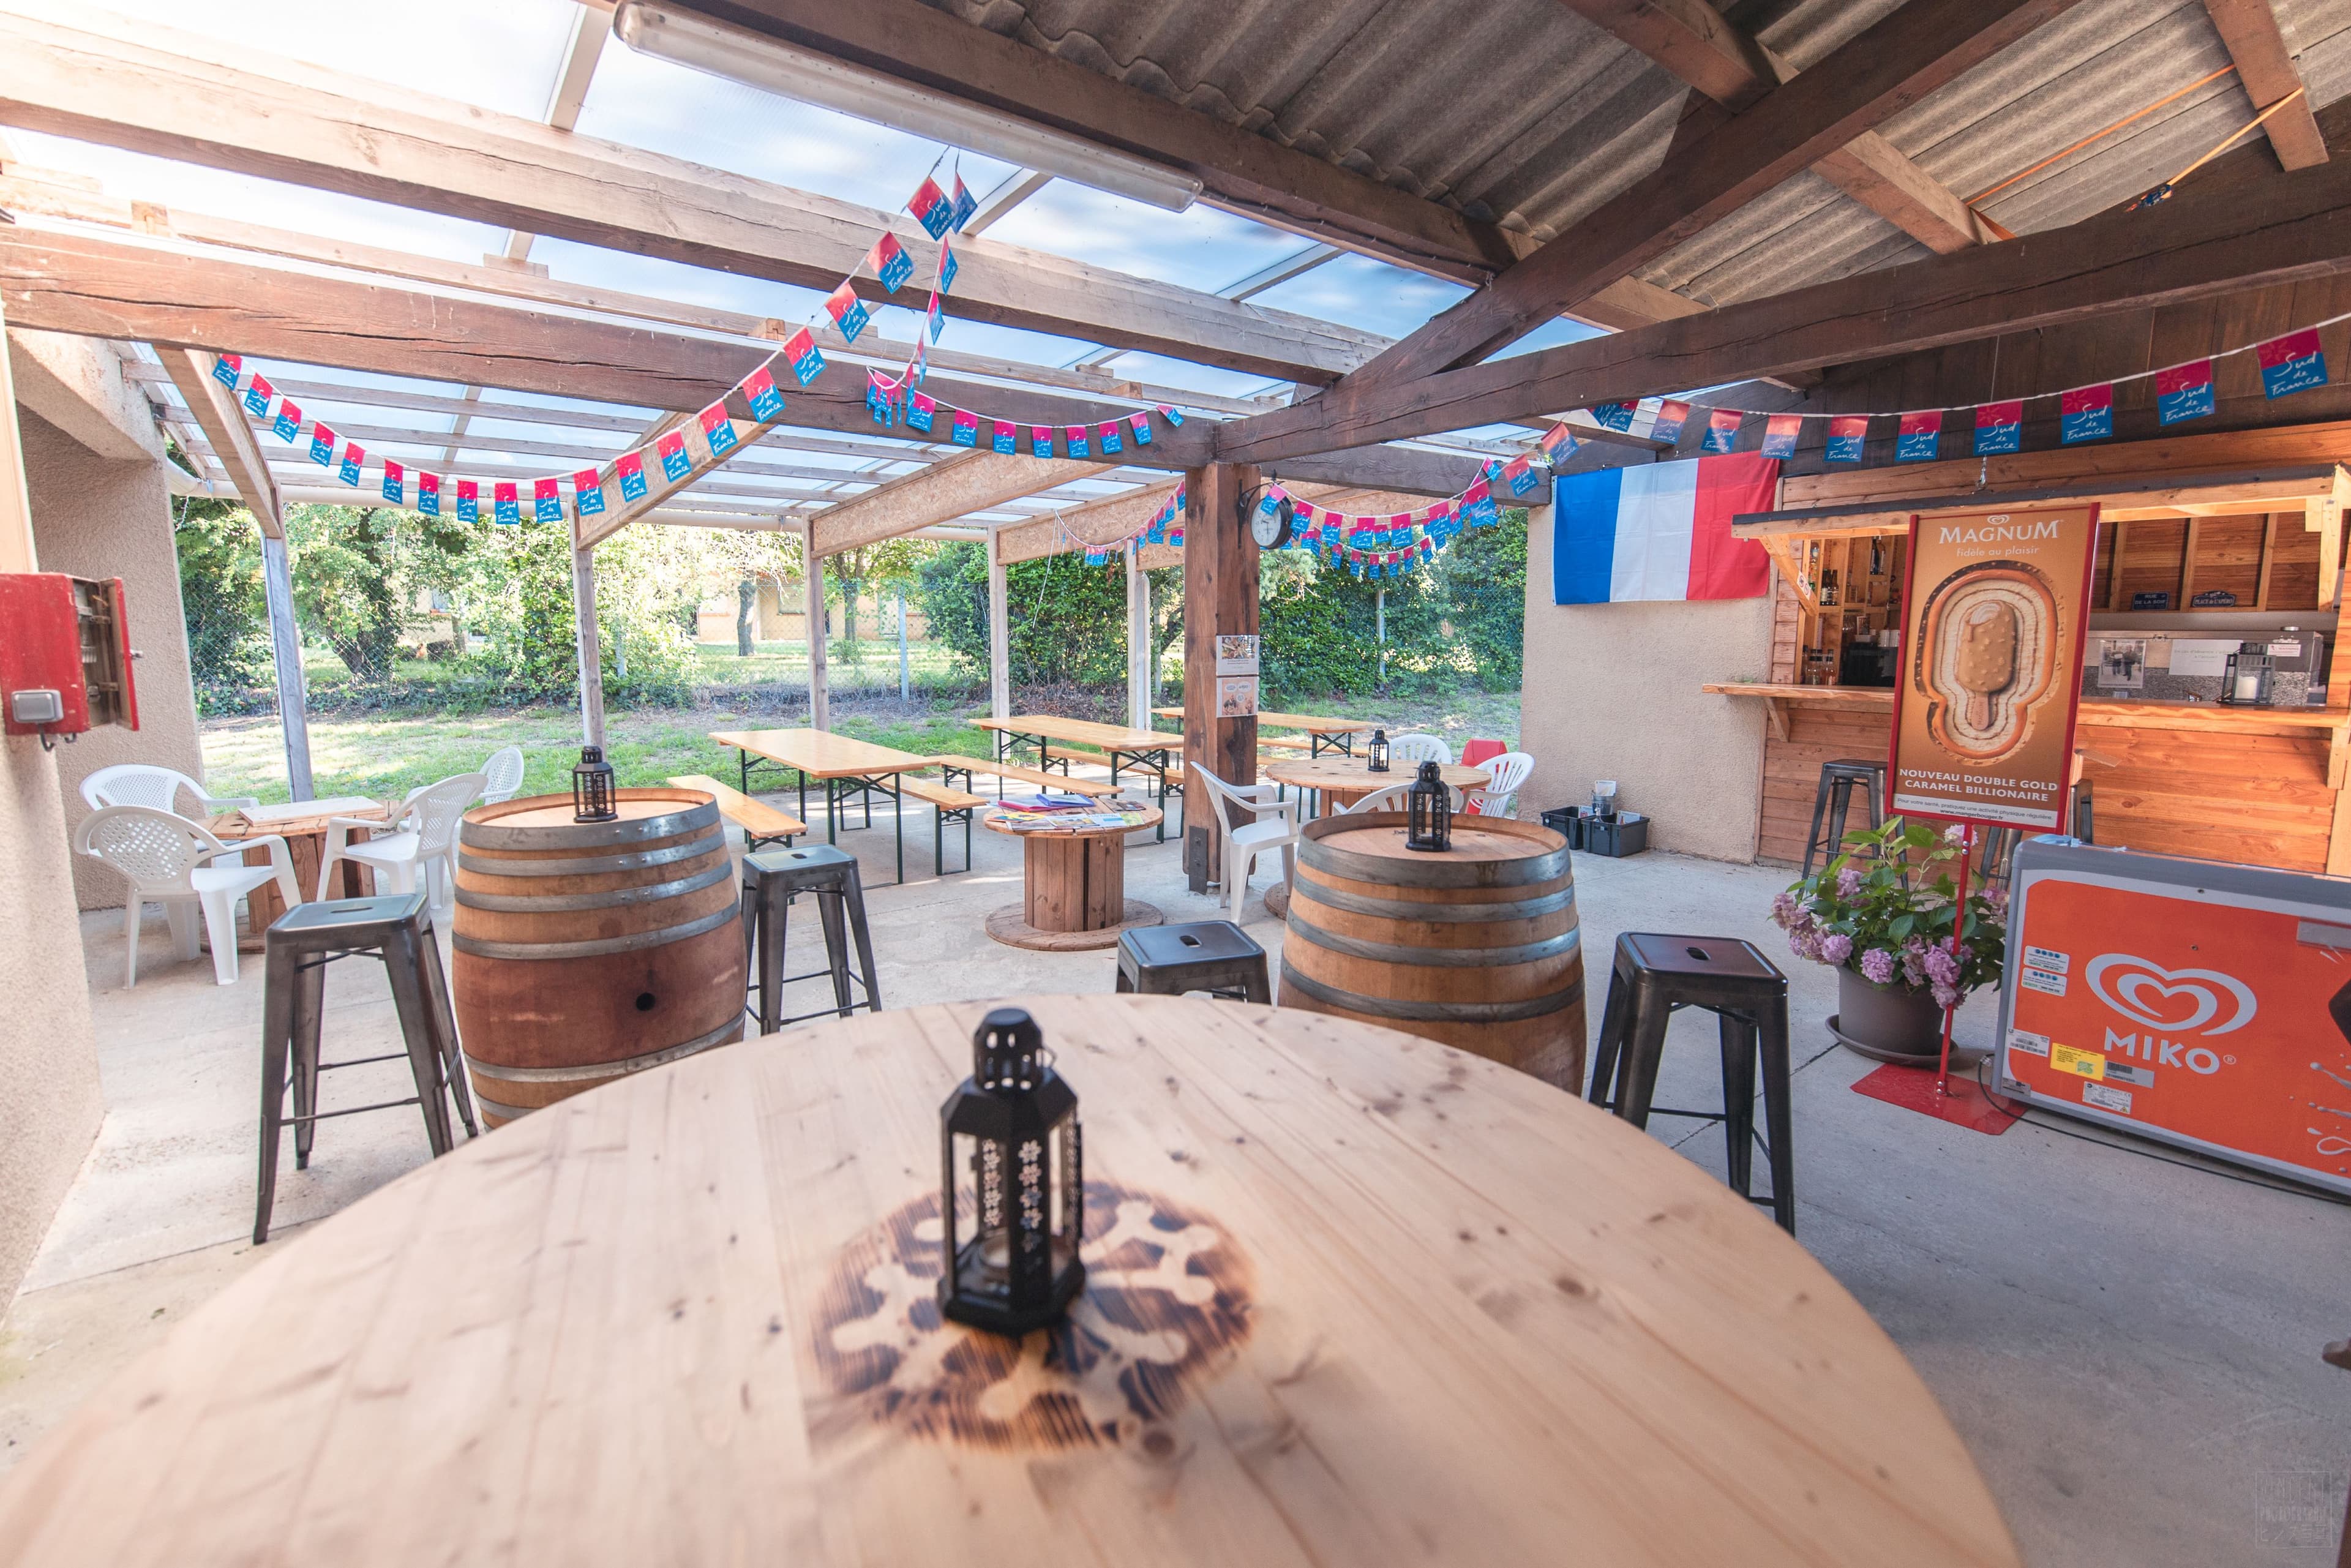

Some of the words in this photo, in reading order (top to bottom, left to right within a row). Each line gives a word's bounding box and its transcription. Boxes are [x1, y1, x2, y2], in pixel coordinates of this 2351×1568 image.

[928, 195, 945, 222] Sud
[932, 209, 956, 236] France
[886, 249, 902, 276] Sud
[888, 263, 912, 289] France
[844, 298, 858, 324] Sud
[847, 314, 867, 339] France
[801, 345, 816, 369] Sud
[2275, 350, 2318, 377] Sud
[801, 362, 824, 383] France
[2169, 381, 2208, 404] Sud
[2271, 375, 2323, 396] France
[252, 388, 268, 402] Sud
[757, 384, 774, 406] Sud
[246, 399, 264, 416] France
[758, 401, 783, 420] France
[913, 406, 933, 417] Sud
[2071, 403, 2107, 423] Sud
[2164, 405, 2210, 421] France
[280, 415, 298, 428] Sud
[713, 418, 729, 439] Sud
[909, 417, 929, 429] France
[958, 422, 975, 433] Sud
[1660, 415, 1683, 428] Sud
[1983, 418, 2017, 437] Sud
[275, 424, 291, 440] France
[997, 431, 1014, 441] Sud
[1106, 430, 1119, 443] Sud
[1653, 432, 1676, 441] France
[1711, 424, 1736, 436] Sud
[1770, 429, 1795, 443] Sud
[1905, 426, 1937, 443] Sud
[2066, 427, 2109, 440] France
[954, 435, 974, 445] France
[1037, 436, 1051, 447] Sud
[1072, 436, 1086, 446] Sud
[1556, 434, 1570, 452] Sud
[1834, 430, 1862, 445] Sud
[315, 438, 331, 452] Sud
[714, 437, 736, 454] France
[1704, 440, 1731, 450] France
[1978, 441, 2017, 452] France
[311, 450, 328, 464] France
[669, 446, 683, 465] Sud
[1558, 445, 1577, 463] France
[1764, 448, 1791, 457] France
[1828, 450, 1859, 459] France
[1900, 448, 1935, 458] France
[345, 457, 360, 470] Sud
[341, 470, 357, 483] France
[626, 467, 641, 485] Sud
[669, 465, 689, 479] France
[1516, 467, 1529, 484] Sud
[387, 475, 402, 487] Sud
[1516, 479, 1536, 494] France
[384, 489, 401, 501] France
[422, 486, 438, 498] Sud
[583, 482, 599, 500] Sud
[626, 486, 645, 499] France
[460, 493, 476, 506] Sud
[500, 495, 516, 509] Sud
[541, 492, 558, 508] Sud
[1475, 495, 1490, 509] Sud
[419, 502, 438, 512] France
[582, 503, 603, 513] France
[1474, 506, 1494, 518] France
[459, 511, 476, 520] France
[498, 514, 518, 522] France
[539, 511, 561, 520] France
[1434, 513, 1449, 526] Sud
[1395, 523, 1411, 535] Sud
[1433, 527, 1450, 536] France
[1939, 520, 2060, 544] MAGNUM
[2005, 546, 2039, 557] plaisir
[1900, 768, 1960, 781] NOUVEAU
[1964, 775, 2015, 787] DOUBLE
[2020, 780, 2058, 791] GOLD
[1905, 780, 1962, 793] CARAMEL
[1966, 786, 2049, 801] BILLIONAIRE
[1940, 809, 2003, 820] www.mangerbouger.fr
